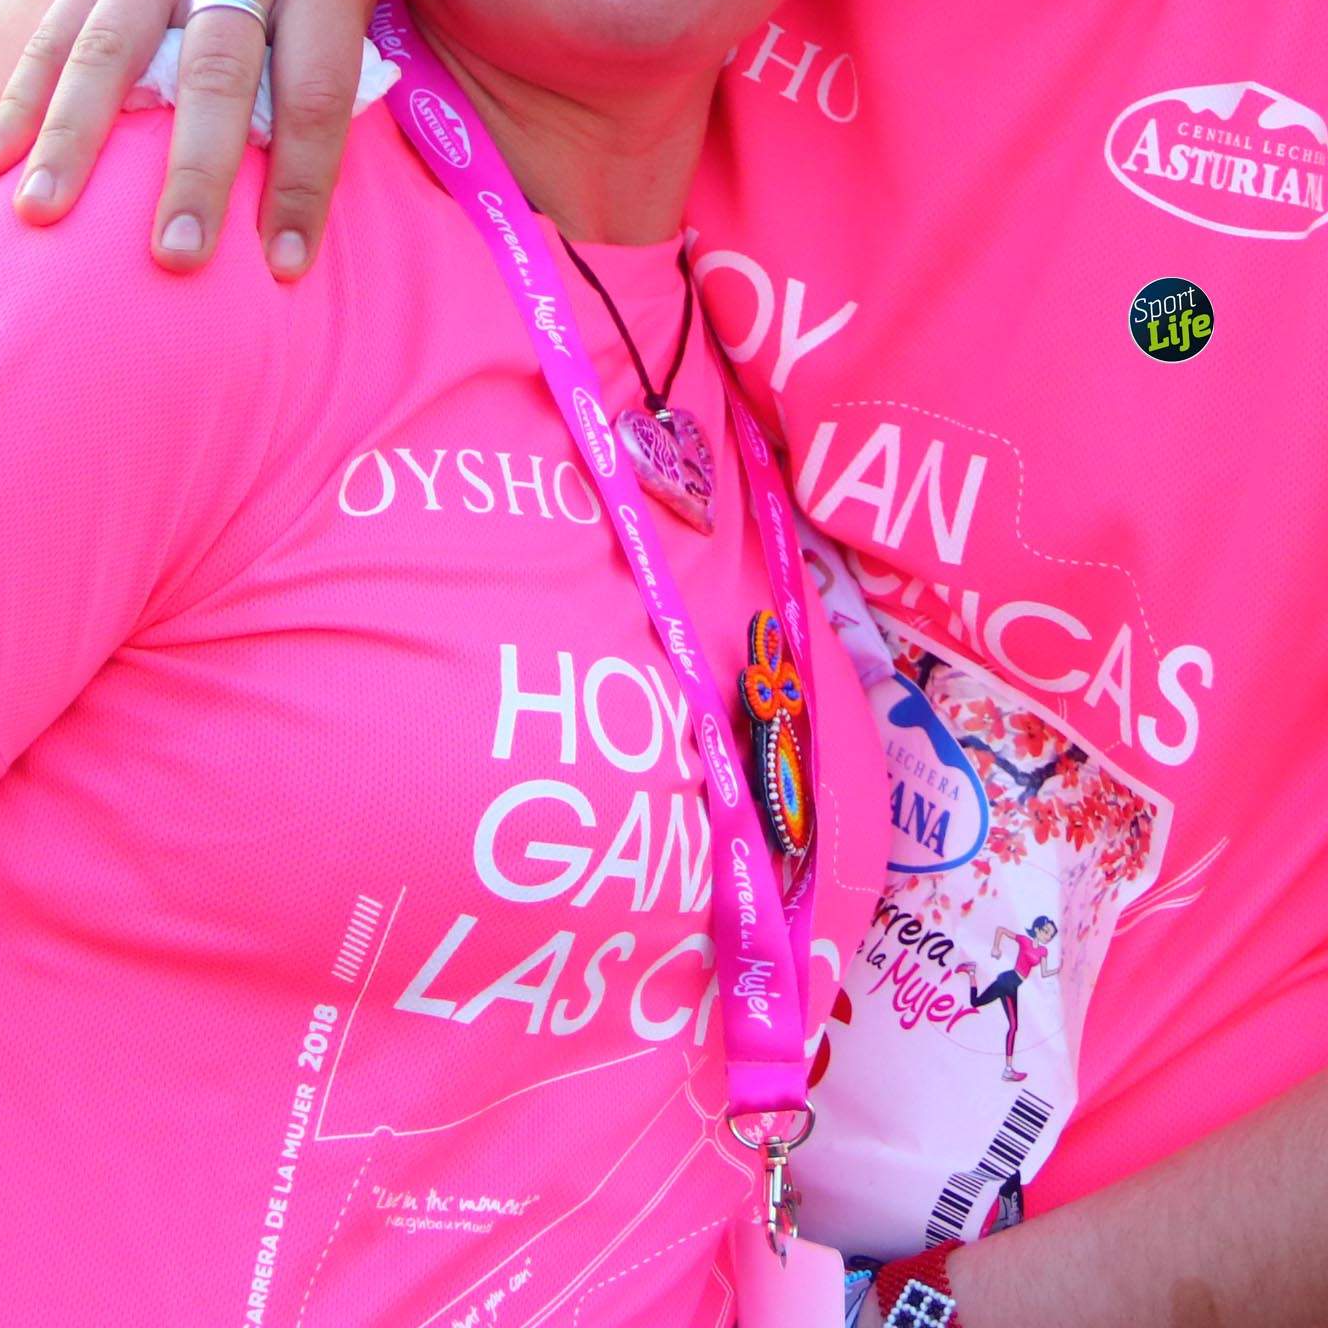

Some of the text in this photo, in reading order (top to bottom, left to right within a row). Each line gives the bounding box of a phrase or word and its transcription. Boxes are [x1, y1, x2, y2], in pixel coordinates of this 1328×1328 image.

[415, 97, 462, 165] ASTURIANA
[477, 190, 529, 265] Carrera
[524, 292, 572, 358] Mujer
[1134, 286, 1197, 323] Sport
[1147, 309, 1212, 353] Life
[338, 446, 602, 524] OYSHO
[617, 504, 657, 588] Carrera
[661, 615, 701, 685] Mujer
[490, 643, 693, 780] HOY
[885, 739, 960, 802] LECHERA
[473, 778, 714, 913] GAN
[730, 837, 757, 927] Carrera
[393, 914, 636, 1037] LAS
[734, 954, 782, 1029] Mujer
[866, 936, 887, 970] la
[867, 948, 980, 1031] Mujer
[243, 1003, 339, 1328] ARRERA DE LA MUJER 2018
